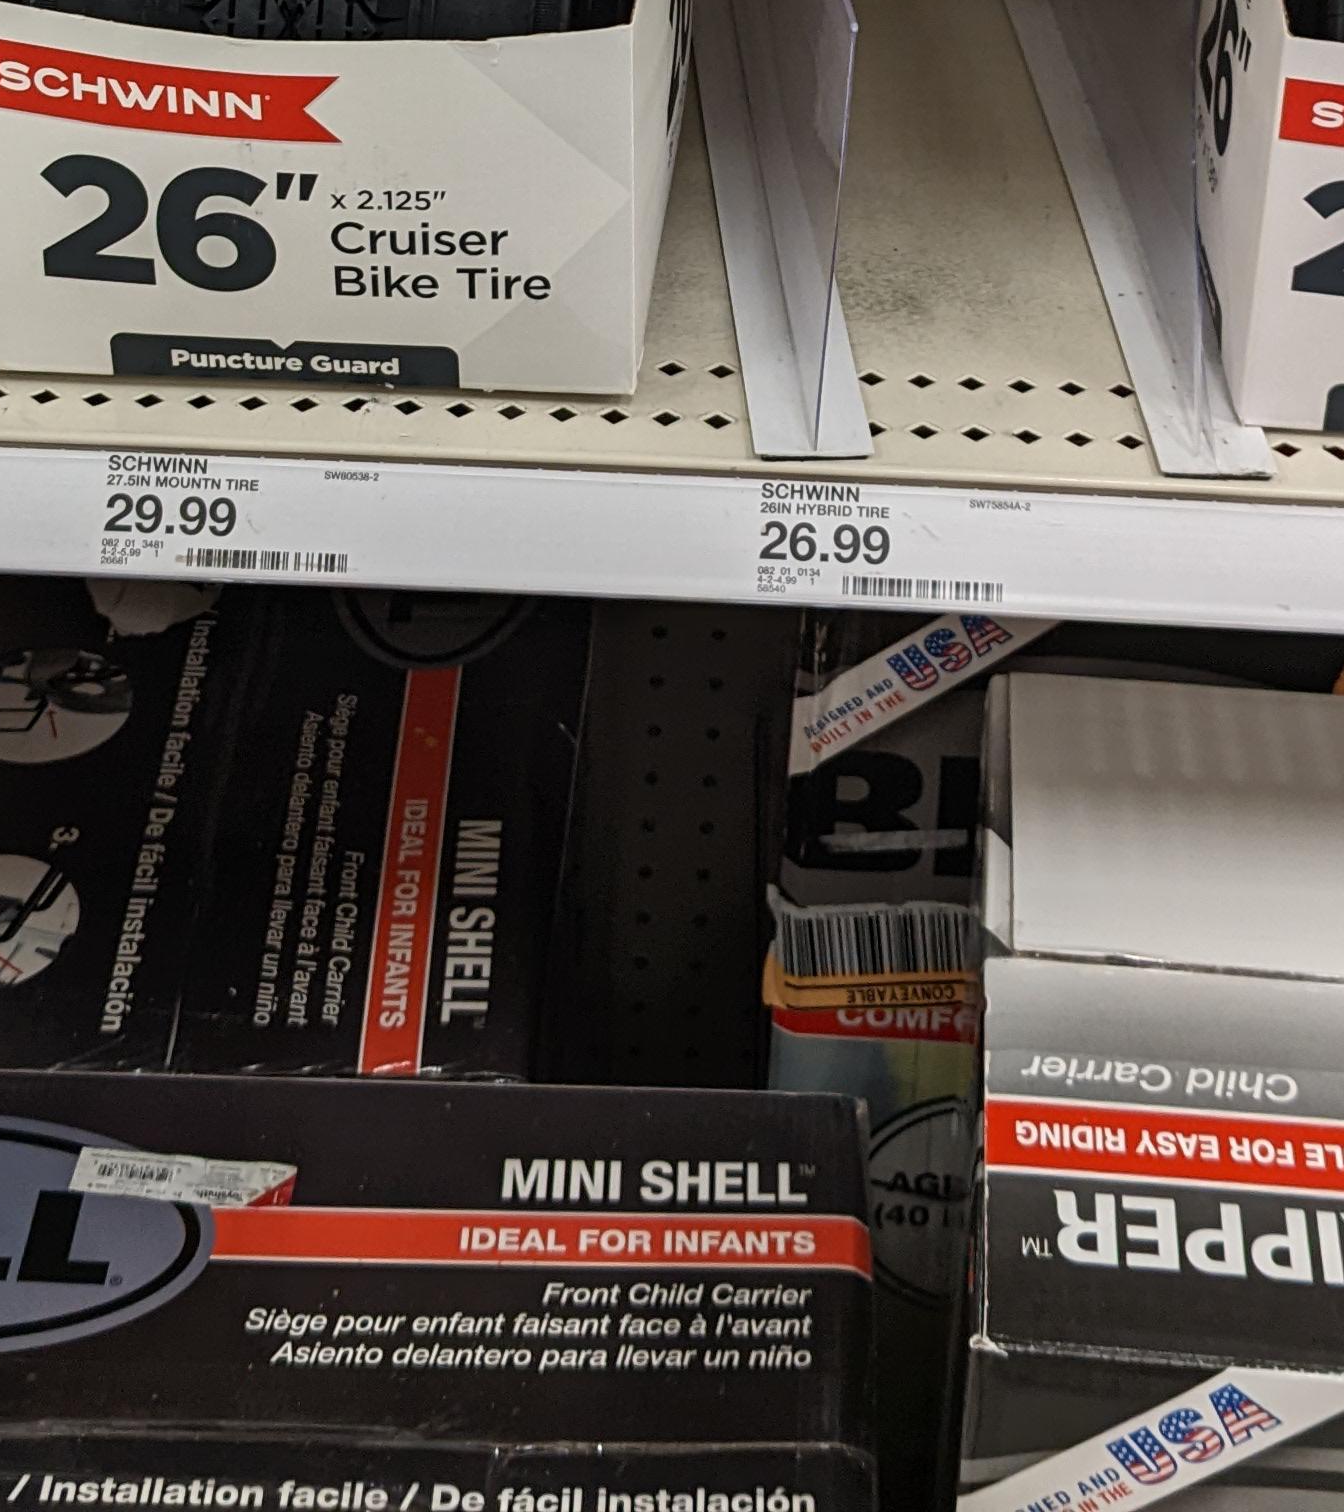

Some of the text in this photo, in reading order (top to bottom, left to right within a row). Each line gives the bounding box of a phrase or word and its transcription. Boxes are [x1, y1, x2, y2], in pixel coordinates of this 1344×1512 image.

[329, 193, 347, 210] x
[329, 221, 509, 258] Cruiser
[331, 265, 553, 303] Bike Tire
[170, 347, 401, 378] Puncture Guard
[108, 454, 208, 475] SCHWINN
[106, 474, 259, 492] 27.5IN MOUNTN TIRE
[761, 482, 860, 502] SCHWINN
[104, 492, 237, 537] 29.99
[759, 520, 890, 565] 26.99
[886, 614, 1013, 691] USA
[1022, 1052, 1298, 1102] Child Carrier
[1014, 1119, 1127, 1150] RIDING
[1136, 1131, 1220, 1162] EASY
[1230, 1136, 1295, 1169] FOR
[500, 1157, 622, 1203] MINI
[458, 1226, 817, 1256] IDEAL FOR INFANTS
[542, 1282, 813, 1308] Front Child Carrier
[245, 1307, 813, 1338] Siège pour enfant faisant face à l'avant
[1105, 1383, 1282, 1486] USA
